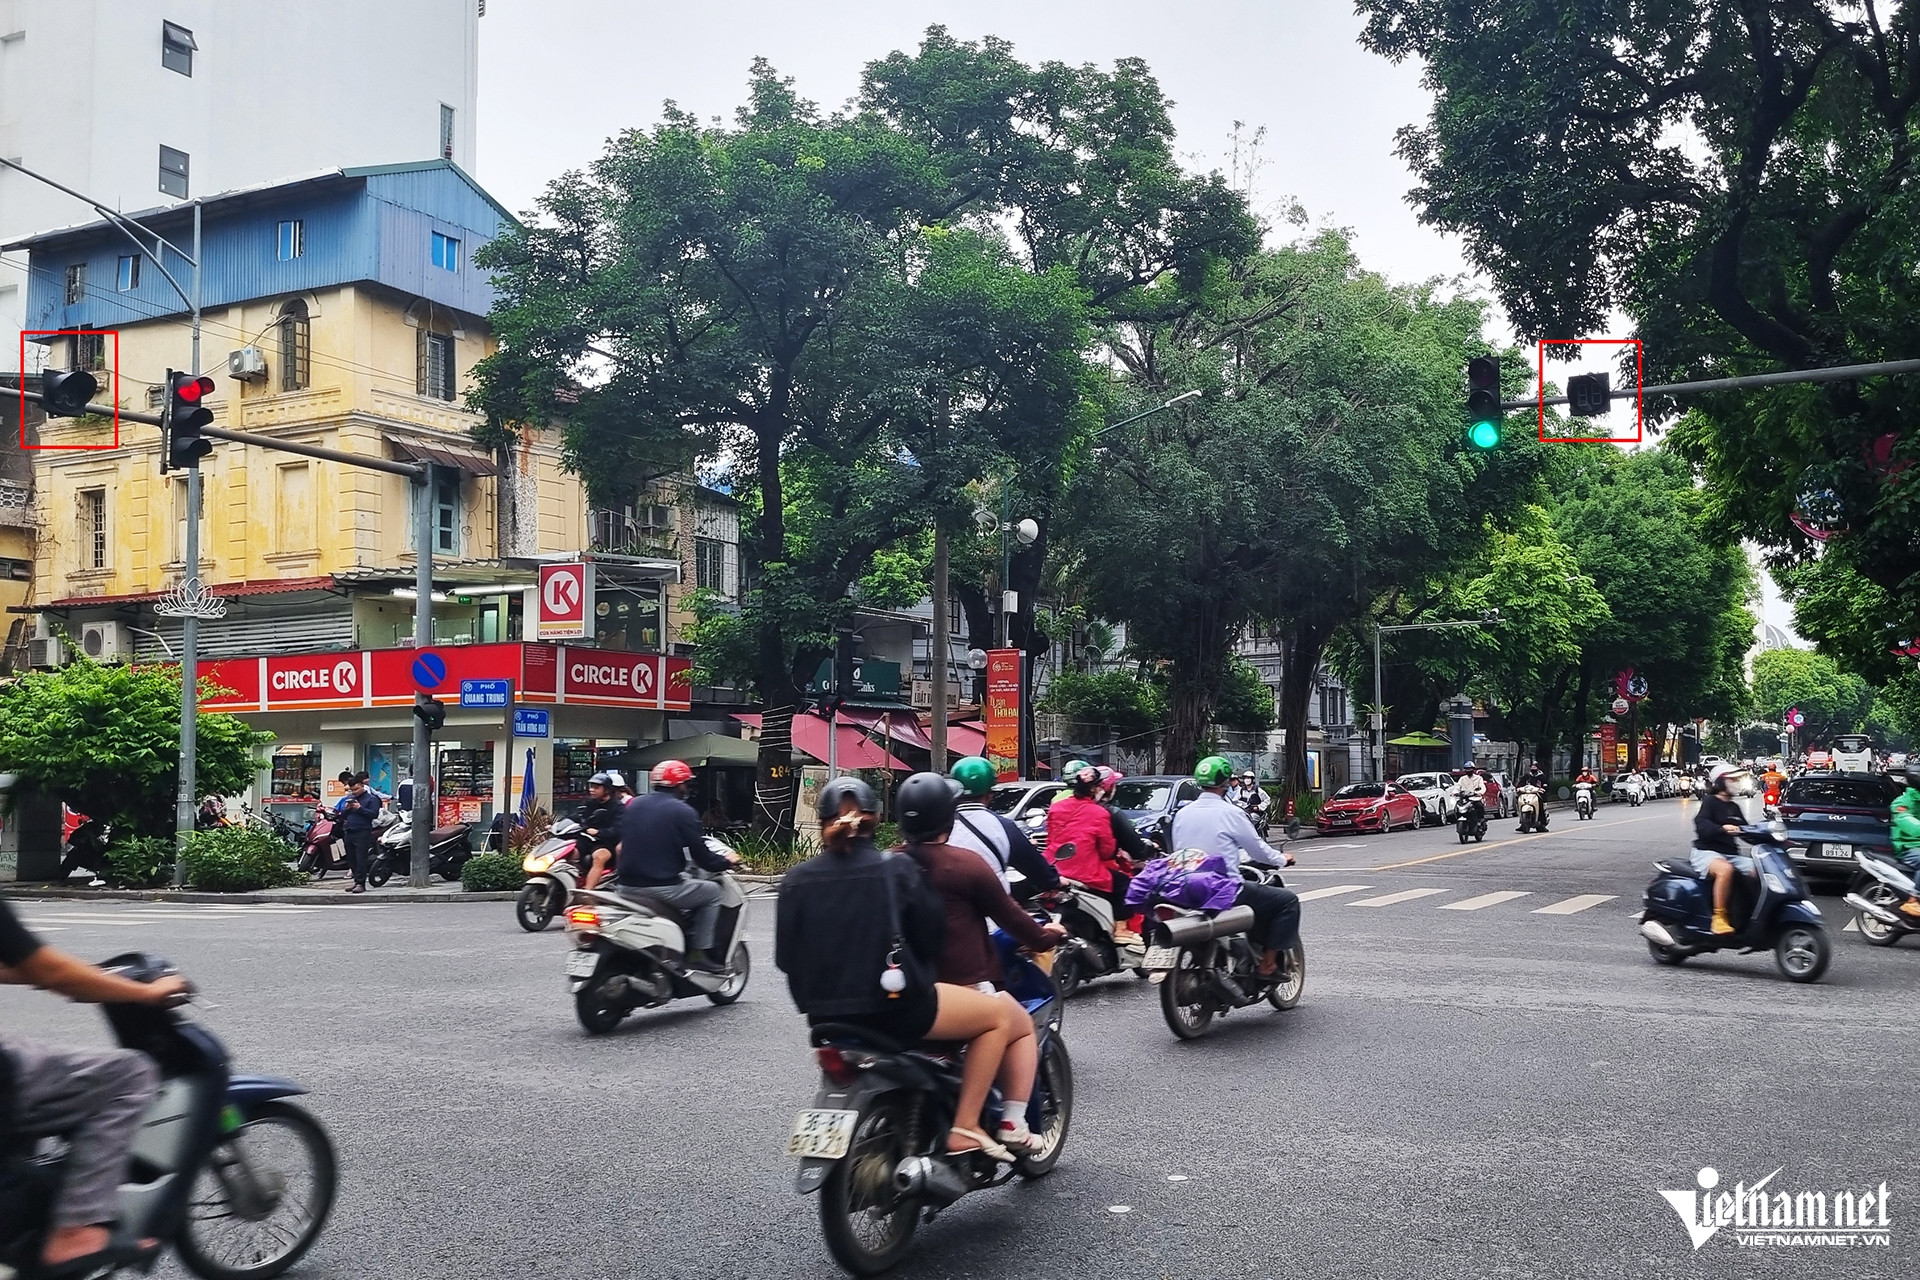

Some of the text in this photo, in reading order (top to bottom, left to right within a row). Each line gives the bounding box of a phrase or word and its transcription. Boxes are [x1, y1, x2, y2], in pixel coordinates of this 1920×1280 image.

[272, 669, 330, 690] CIRCLE
[571, 663, 628, 686] CIRCLE
[480, 682, 496, 690] PHỐ
[464, 693, 505, 704] QUANG TRUNG
[527, 712, 539, 720] PHỐ
[515, 720, 526, 733] TRẦN
[527, 722, 538, 733] HƯNG
[770, 765, 791, 778] 284
